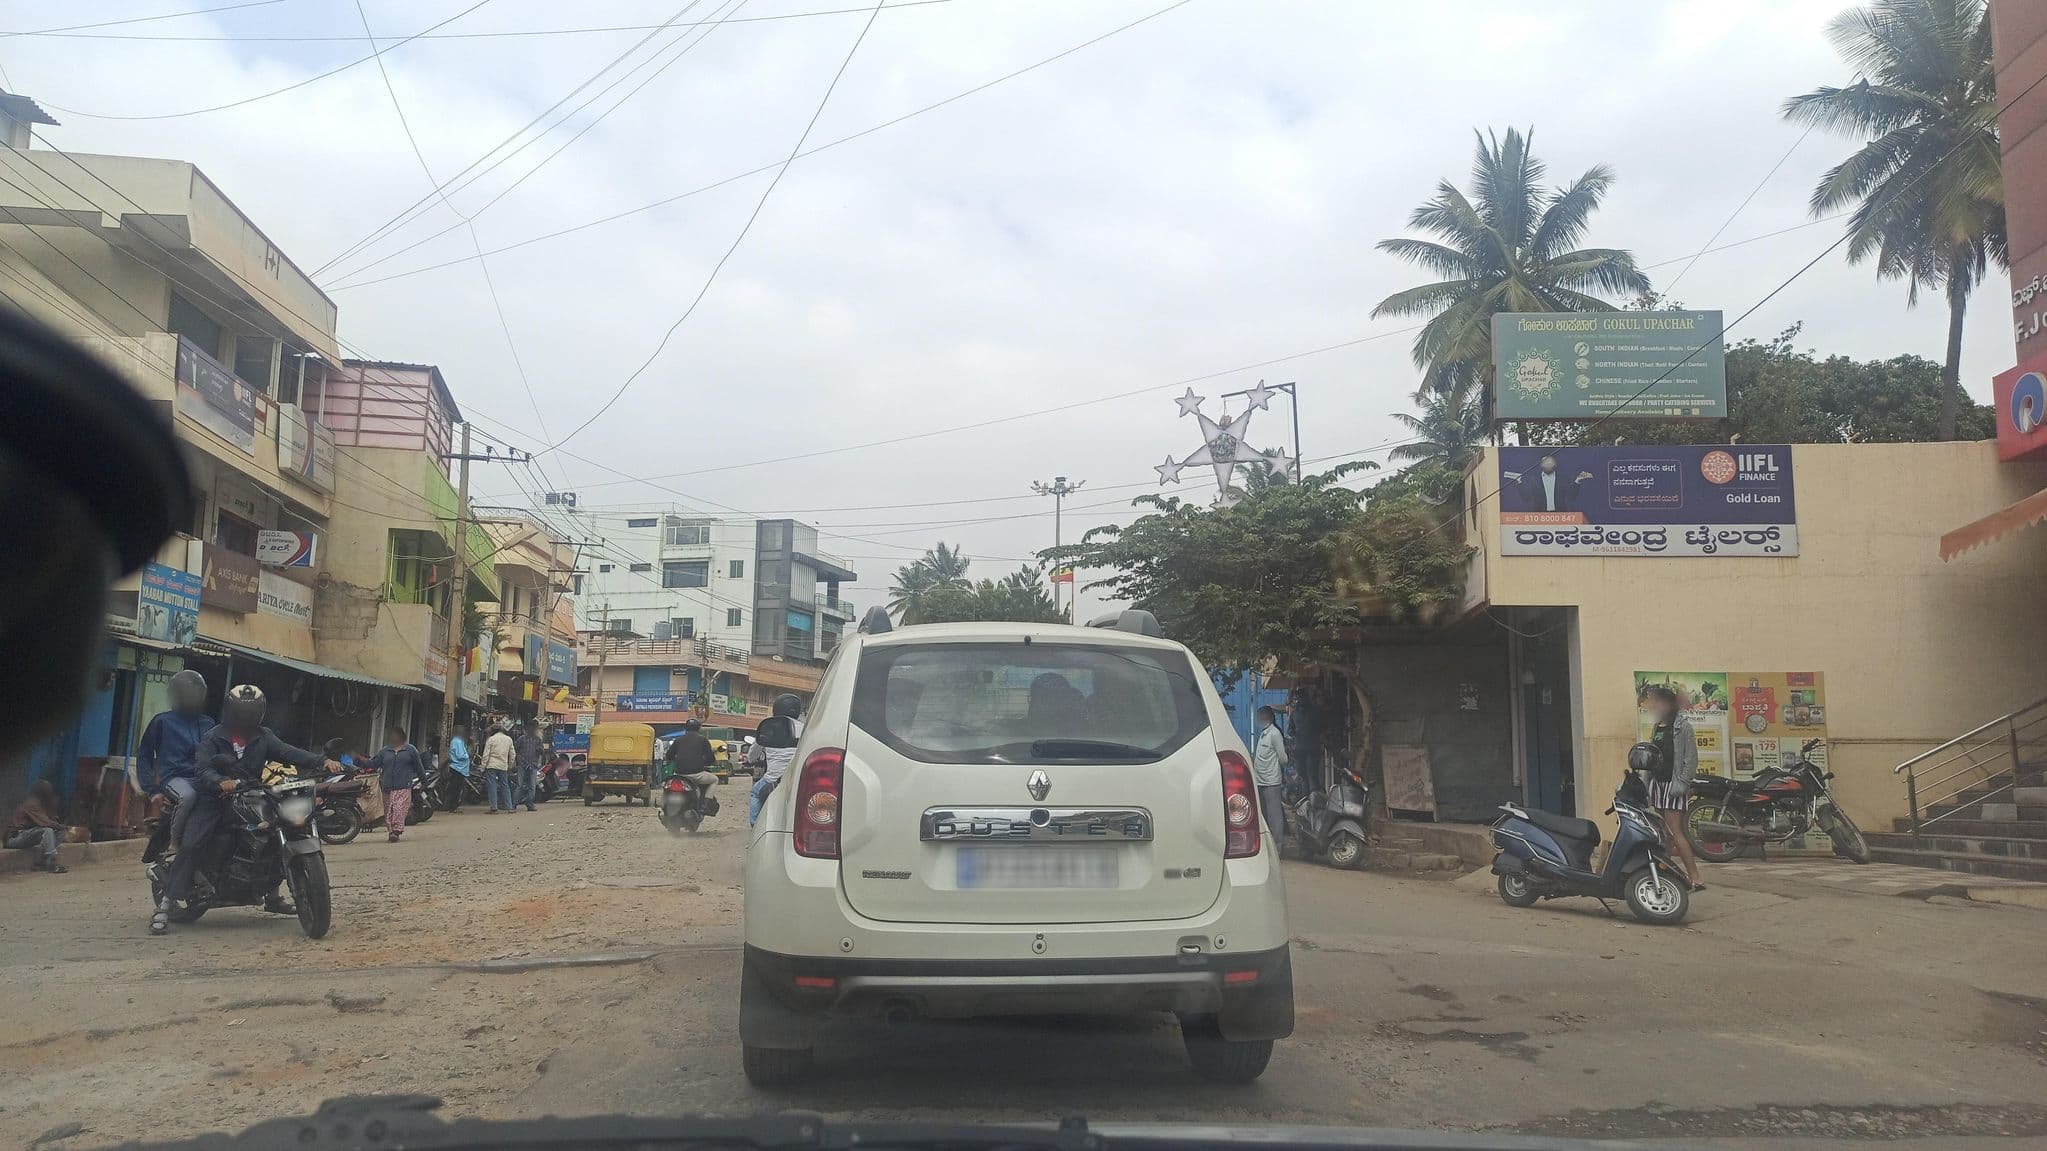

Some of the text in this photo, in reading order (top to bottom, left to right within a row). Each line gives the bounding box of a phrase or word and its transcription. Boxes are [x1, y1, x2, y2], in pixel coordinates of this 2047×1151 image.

[1603, 318, 1641, 330] GOKUL
[1643, 318, 1695, 330] UPACHAR
[1738, 454, 1779, 472] IIFL
[1739, 473, 1776, 481] FINANCE
[1726, 493, 1781, 503] Gold Loan
[1524, 514, 1539, 522] 810
[1540, 514, 1560, 522] 8000
[1515, 525, 1782, 553] ರಾಘವೇಂದ್ರ ಟೈಲರ್ಸ್
[1697, 737, 1708, 747] 69
[934, 821, 1144, 837] DUSTER
